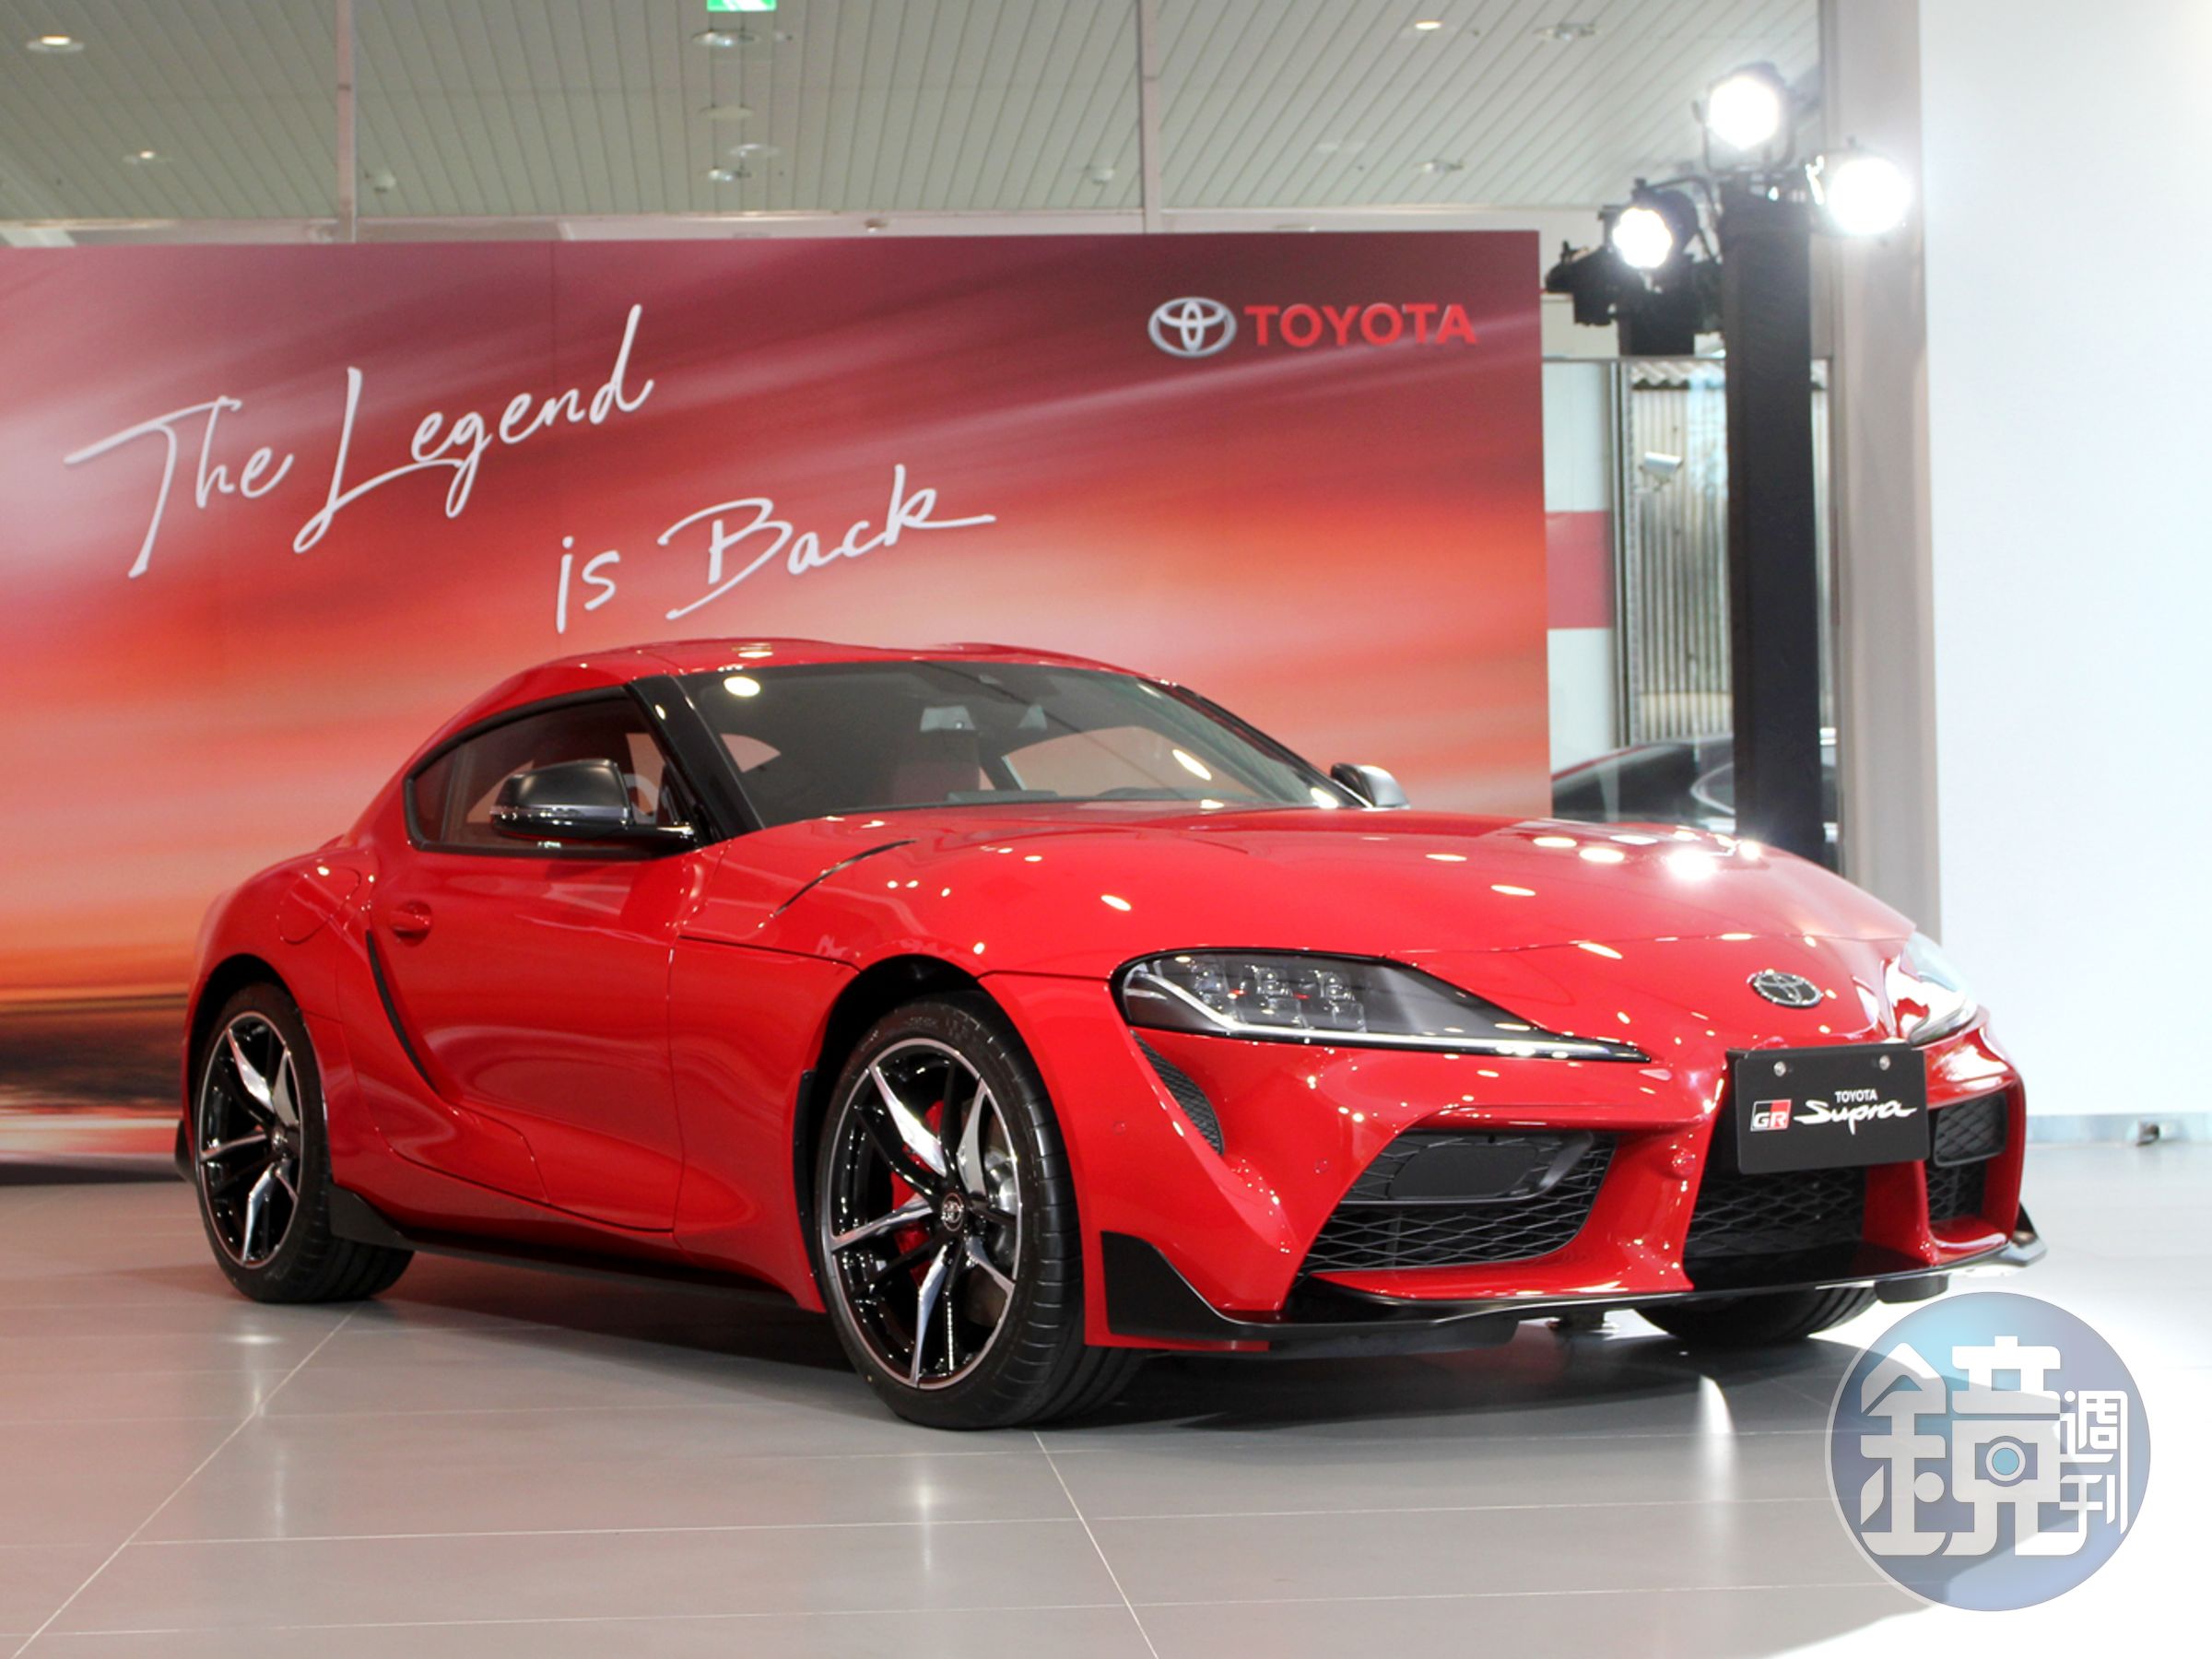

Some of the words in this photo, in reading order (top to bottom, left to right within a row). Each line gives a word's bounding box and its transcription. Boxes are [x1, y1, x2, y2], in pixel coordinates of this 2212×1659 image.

[1244, 302, 1477, 347] TOYOTA
[65, 396, 294, 579] The
[293, 303, 655, 554] Legend
[556, 536, 620, 633] is
[657, 464, 996, 619] Back
[1754, 1112, 1788, 1129] GR
[1794, 1100, 1917, 1135] Supra
[1834, 1088, 1878, 1103] TOYOTA
